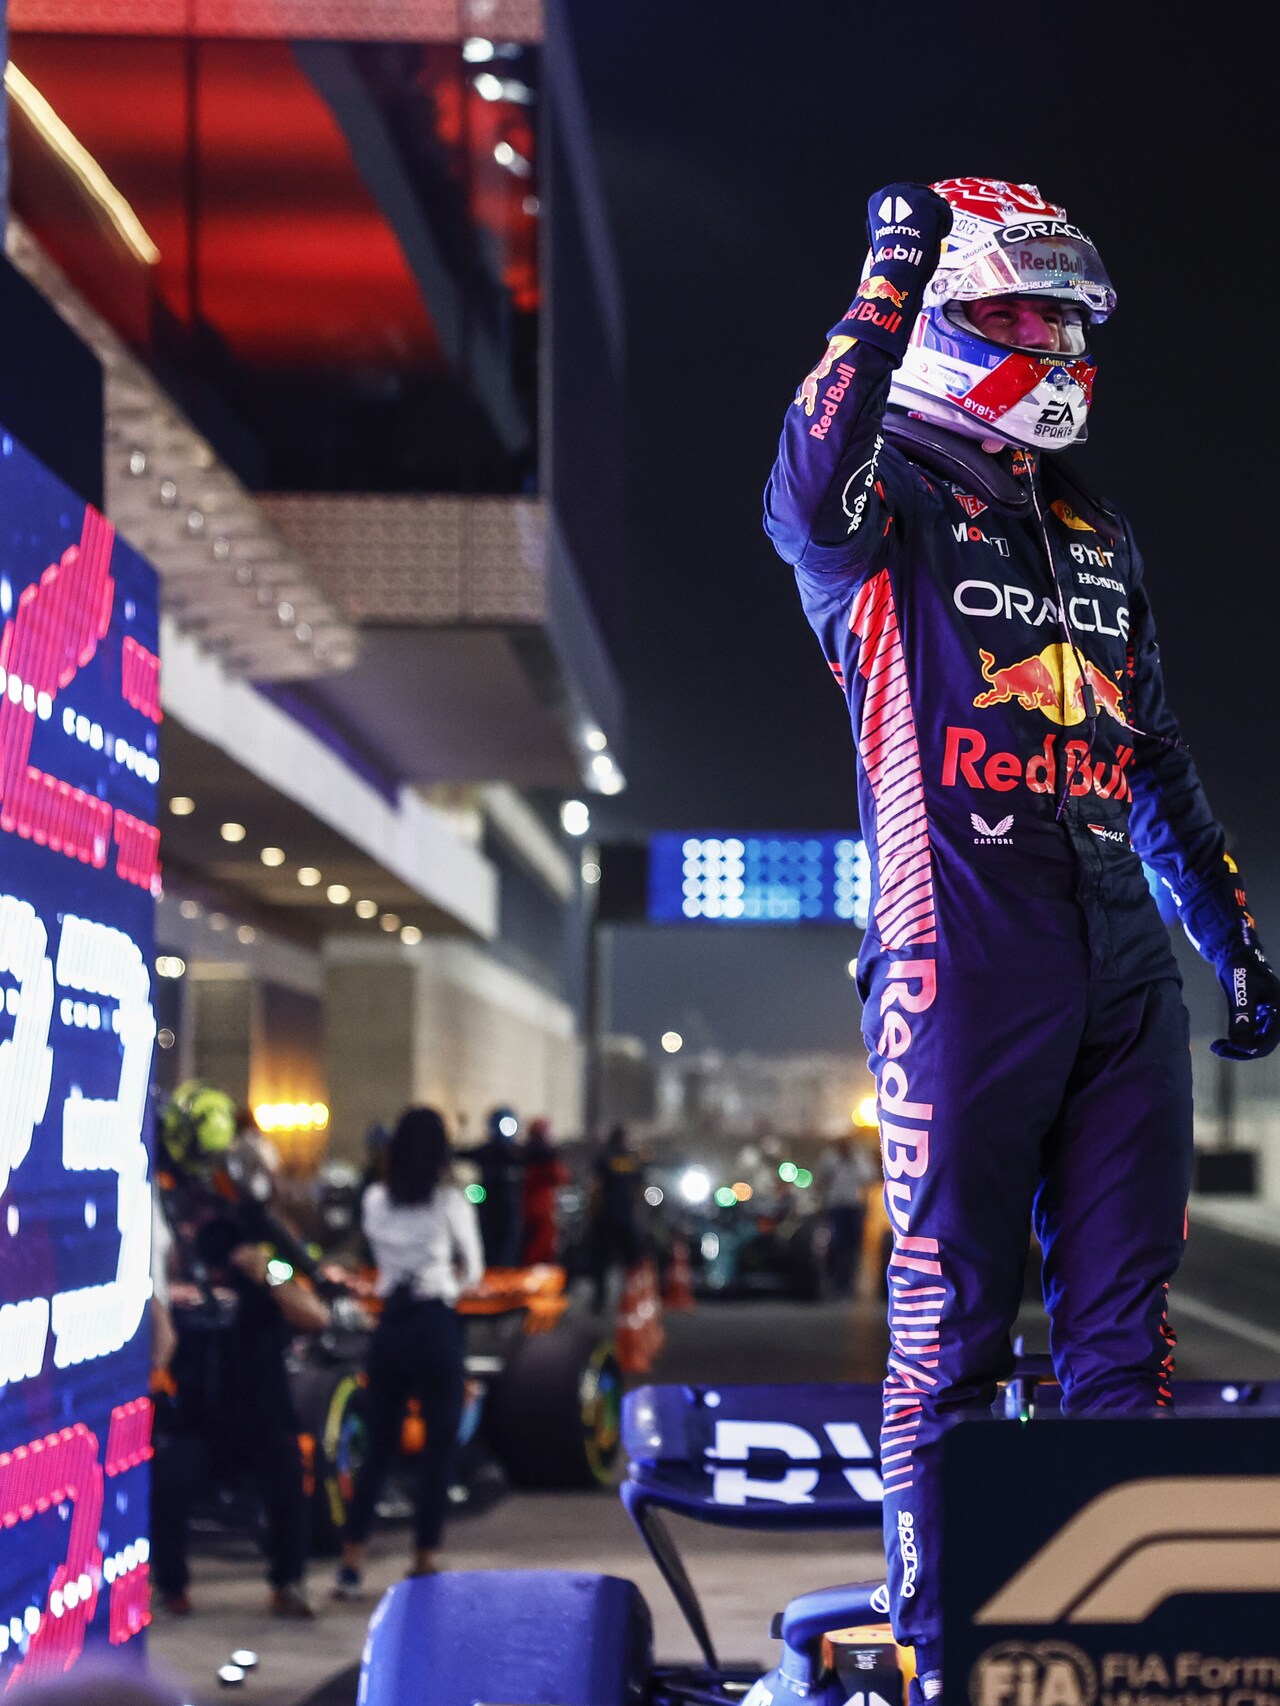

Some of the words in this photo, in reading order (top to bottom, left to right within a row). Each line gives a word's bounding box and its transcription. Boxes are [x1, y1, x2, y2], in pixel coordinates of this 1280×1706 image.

[1002, 221, 1093, 246] ORACL
[1020, 250, 1056, 271] Red
[1059, 252, 1083, 274] Bull
[858, 303, 903, 334] Bull
[809, 398, 839, 440] Red
[826, 363, 857, 403] Bull
[1038, 401, 1074, 425] EA
[1034, 424, 1073, 438] SPORTS
[1077, 572, 1126, 595] HONDA
[952, 579, 1130, 643] ORACLE
[941, 726, 1056, 794] Red
[1065, 739, 1133, 803] Bull
[973, 837, 1014, 845] CASTORE
[1101, 830, 1125, 843] MAX
[1234, 968, 1247, 1008] sparco
[877, 957, 938, 1120] Red
[898, 1511, 918, 1598] sparco
[1101, 1651, 1170, 1688] FIA
